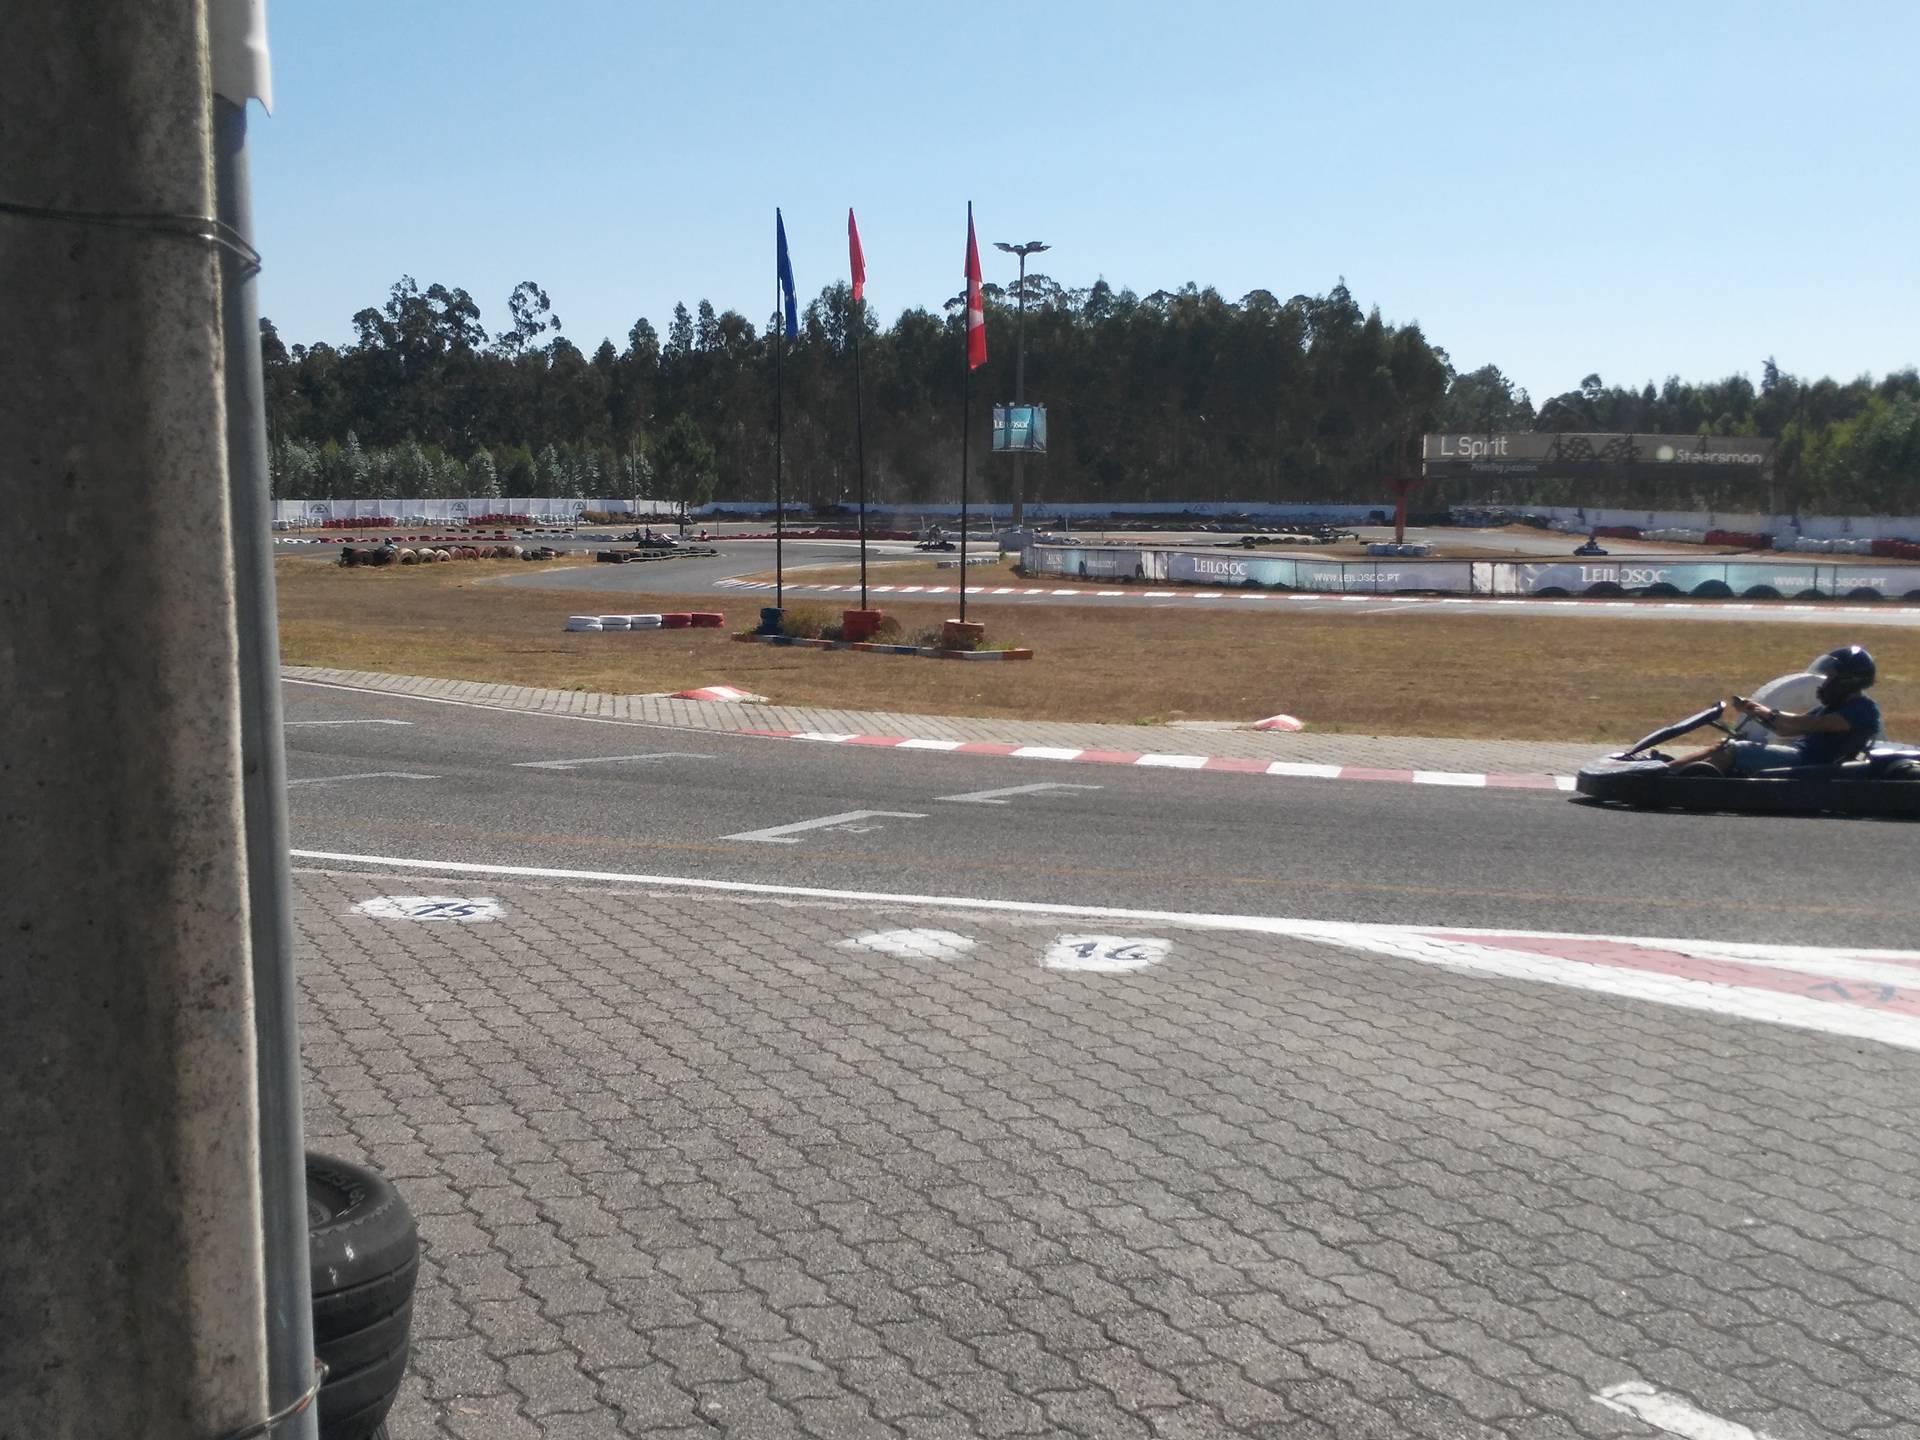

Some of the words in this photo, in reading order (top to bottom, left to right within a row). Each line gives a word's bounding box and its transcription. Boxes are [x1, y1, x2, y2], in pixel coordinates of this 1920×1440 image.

[1441, 436, 1454, 456] L
[1458, 436, 1508, 460] Spirit
[1193, 557, 1248, 576] LEILOSOC
[1579, 566, 1672, 583] LEILOSOC
